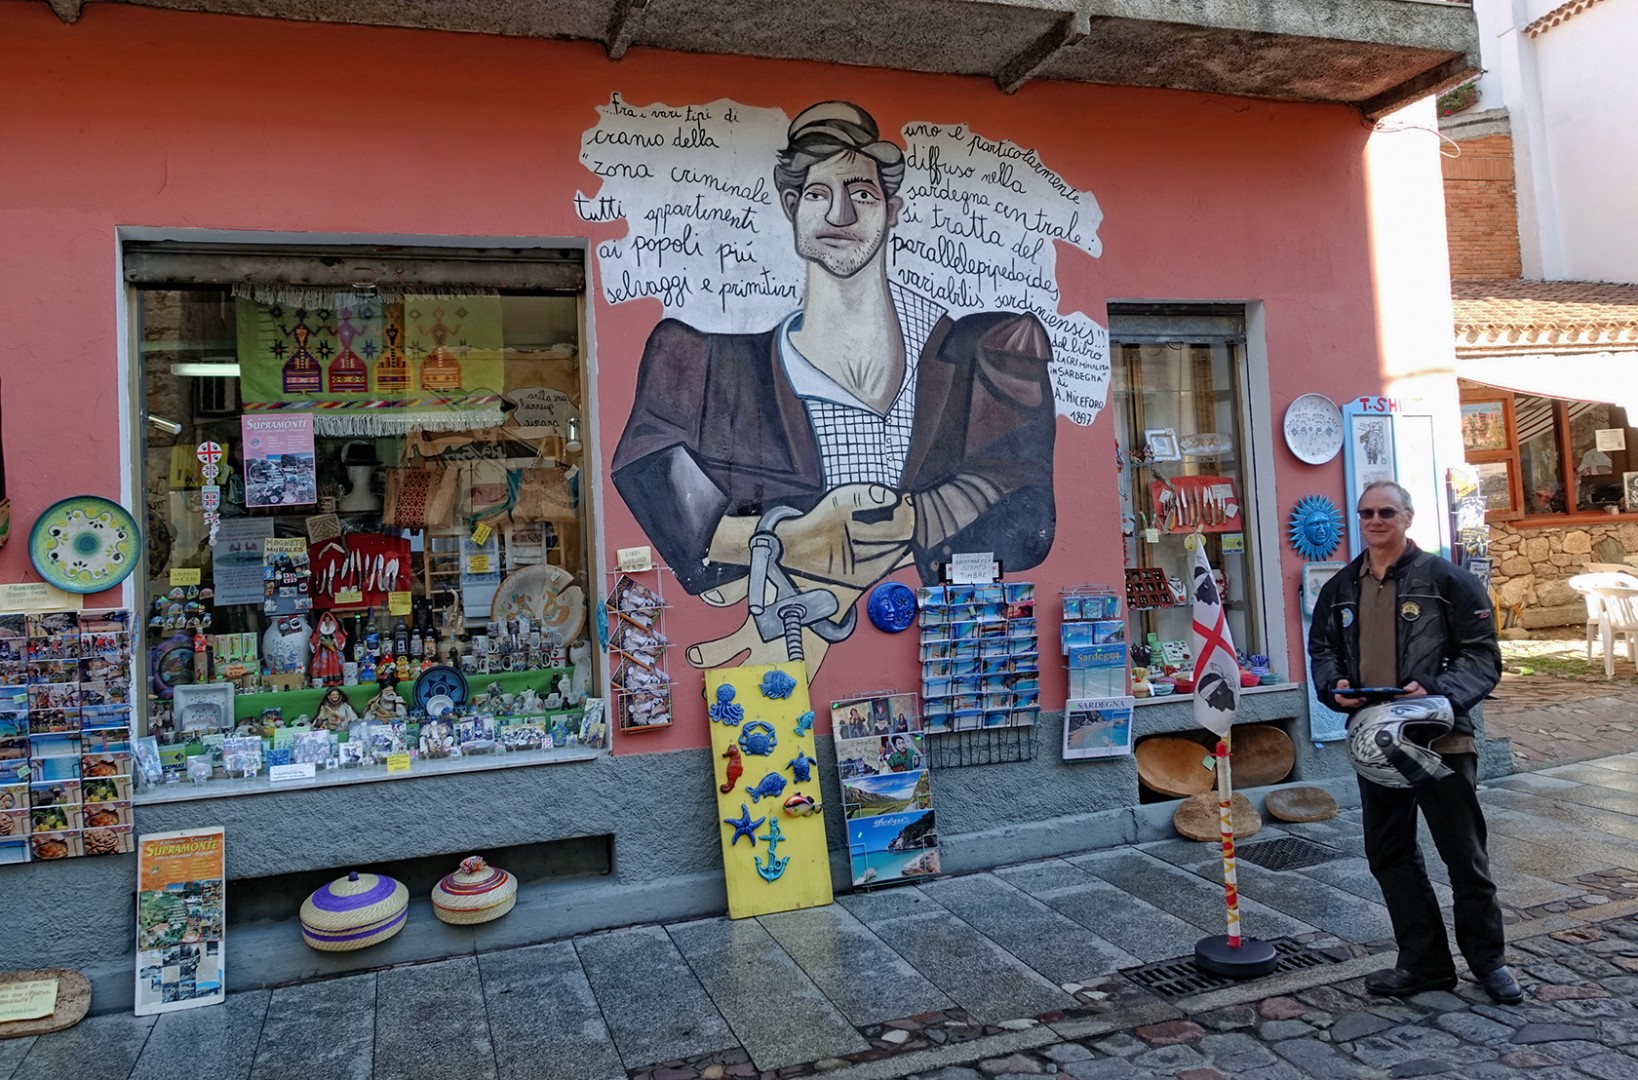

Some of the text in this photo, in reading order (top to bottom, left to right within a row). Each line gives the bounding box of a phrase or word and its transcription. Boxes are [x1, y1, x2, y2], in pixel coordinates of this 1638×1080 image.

[685, 106, 712, 129] tipi
[724, 108, 740, 123] di
[586, 127, 719, 149] cranio della
[904, 123, 942, 138] uno
[966, 134, 1081, 205] particolarmente
[906, 144, 1027, 195] diffuso nella
[671, 166, 771, 205] criminale
[574, 193, 627, 221] tutti
[599, 239, 622, 259] ai
[631, 223, 703, 268] popoli
[902, 202, 1044, 265] si tratta del
[606, 267, 693, 308] selvaggi
[700, 277, 713, 293] e
[898, 268, 985, 309] variabilis
[1051, 333, 1102, 361] del libro
[246, 418, 308, 430] SUPRAMONTE
[1070, 410, 1092, 425] 1897
[1076, 699, 1126, 710] SARDEGNA
[145, 840, 218, 857] SUPRAMONTE
